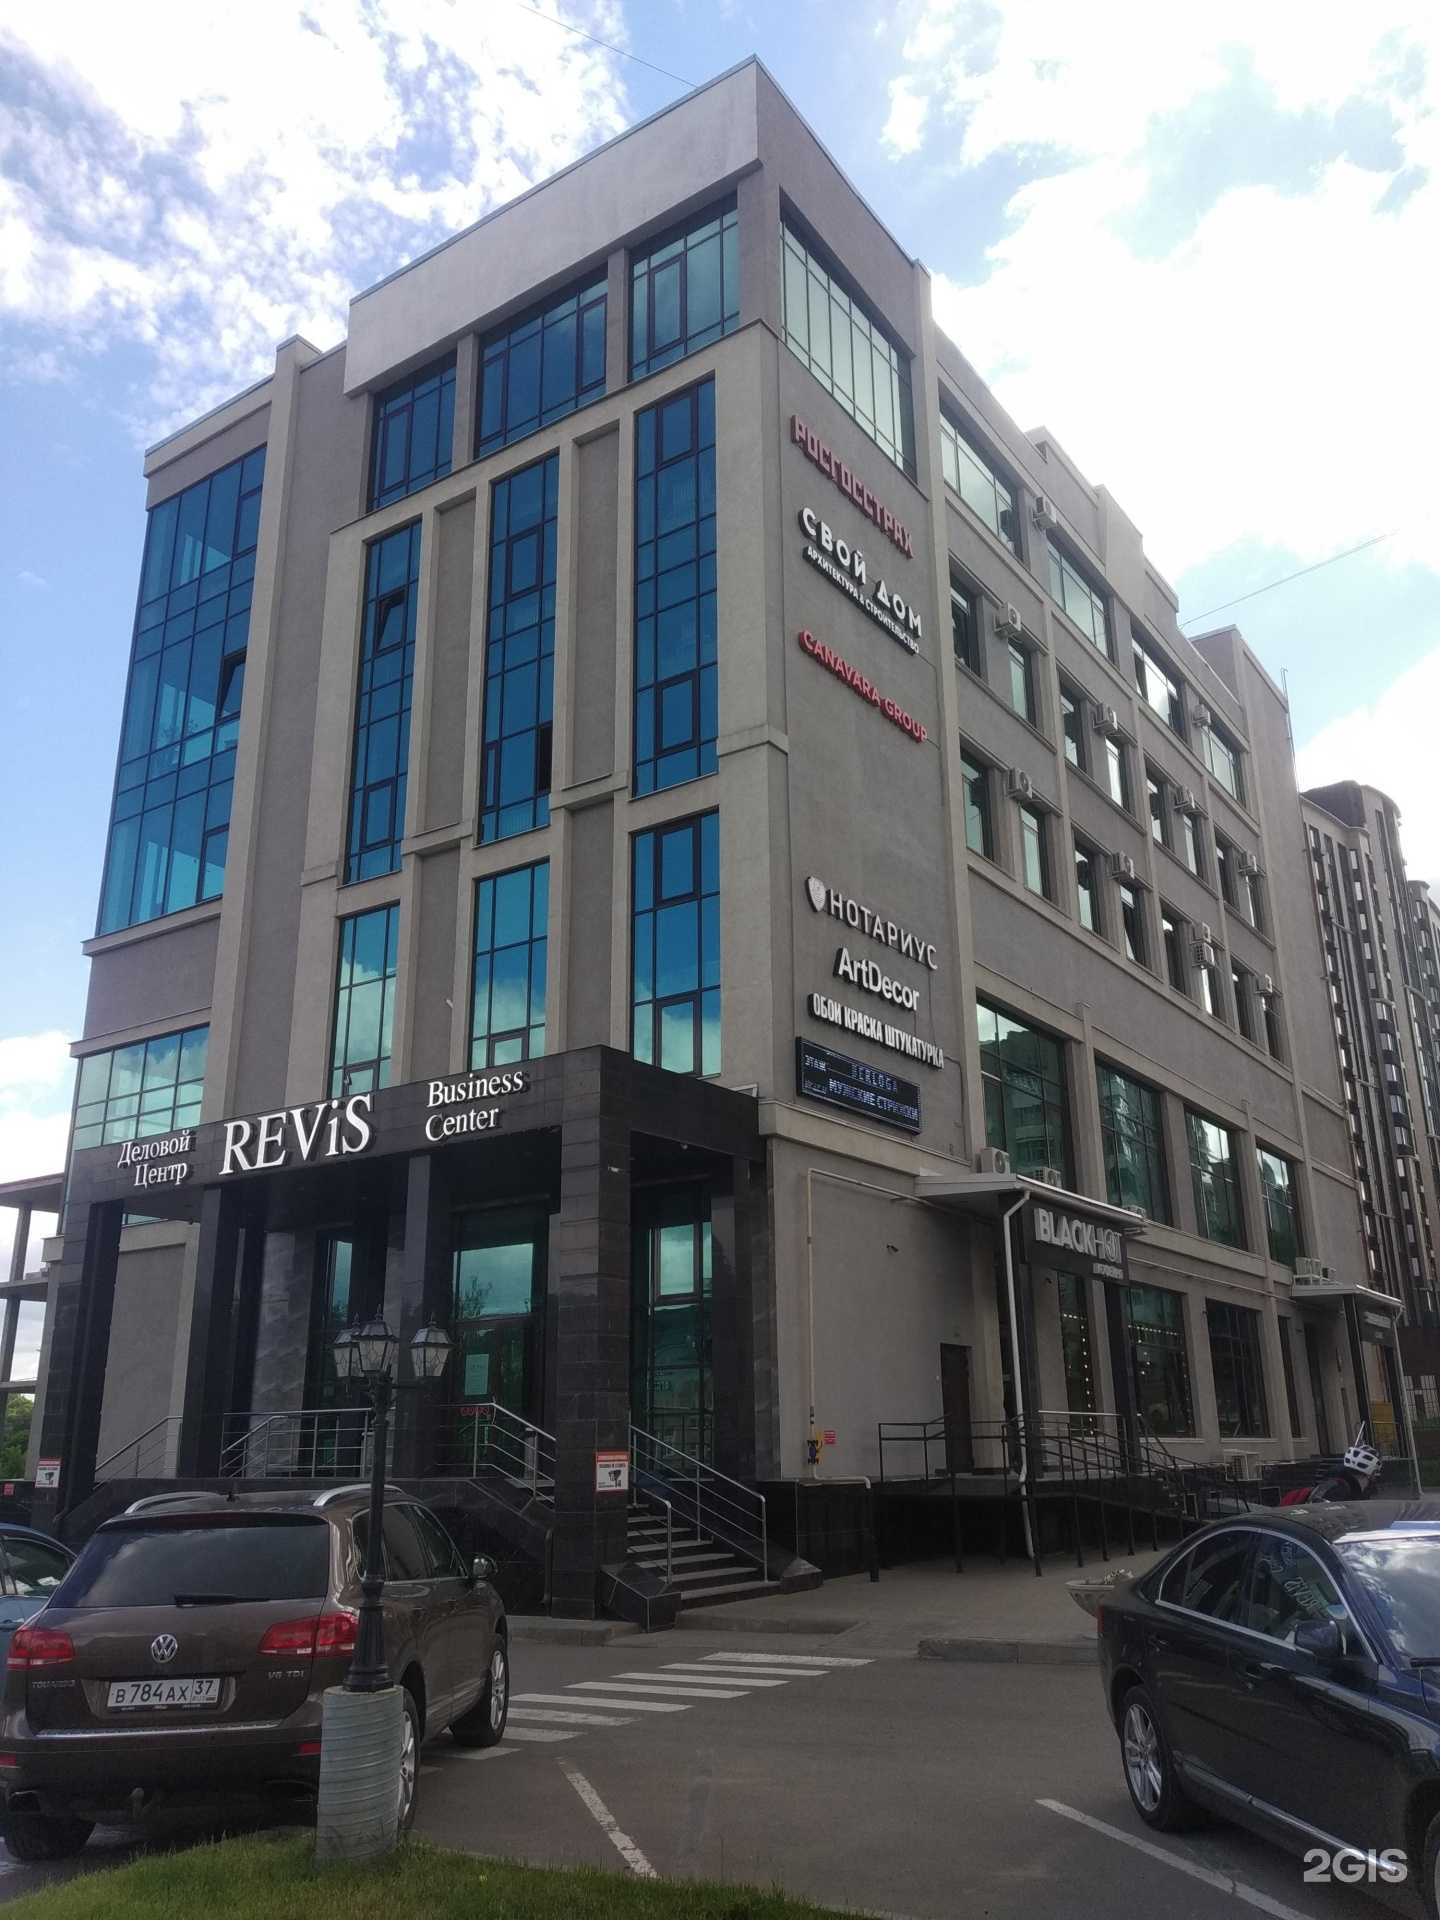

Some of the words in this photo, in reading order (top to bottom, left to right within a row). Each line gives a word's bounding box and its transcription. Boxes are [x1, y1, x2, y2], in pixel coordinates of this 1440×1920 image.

[791, 414, 913, 559] РОСГОССТРАХ
[801, 507, 866, 585] СВОЙ
[876, 580, 922, 637] ДОМ
[807, 545, 859, 600] АРХИТЕКТУРА
[865, 599, 920, 654] СТРОИТЕЛЬСТВО
[801, 630, 881, 709] CANAVARA
[884, 699, 928, 743] GROUP
[828, 888, 938, 971] НОТАРИУС
[837, 947, 920, 1012] ArtDecor
[811, 993, 842, 1026] ОБОИ
[844, 1006, 884, 1044] КРАСКА
[884, 1024, 944, 1069] ШТУКАТУРКА
[425, 1105, 500, 1142] Center
[427, 1070, 524, 1109] Business
[117, 1129, 191, 1168] Деловой
[134, 1162, 187, 1189] Центр
